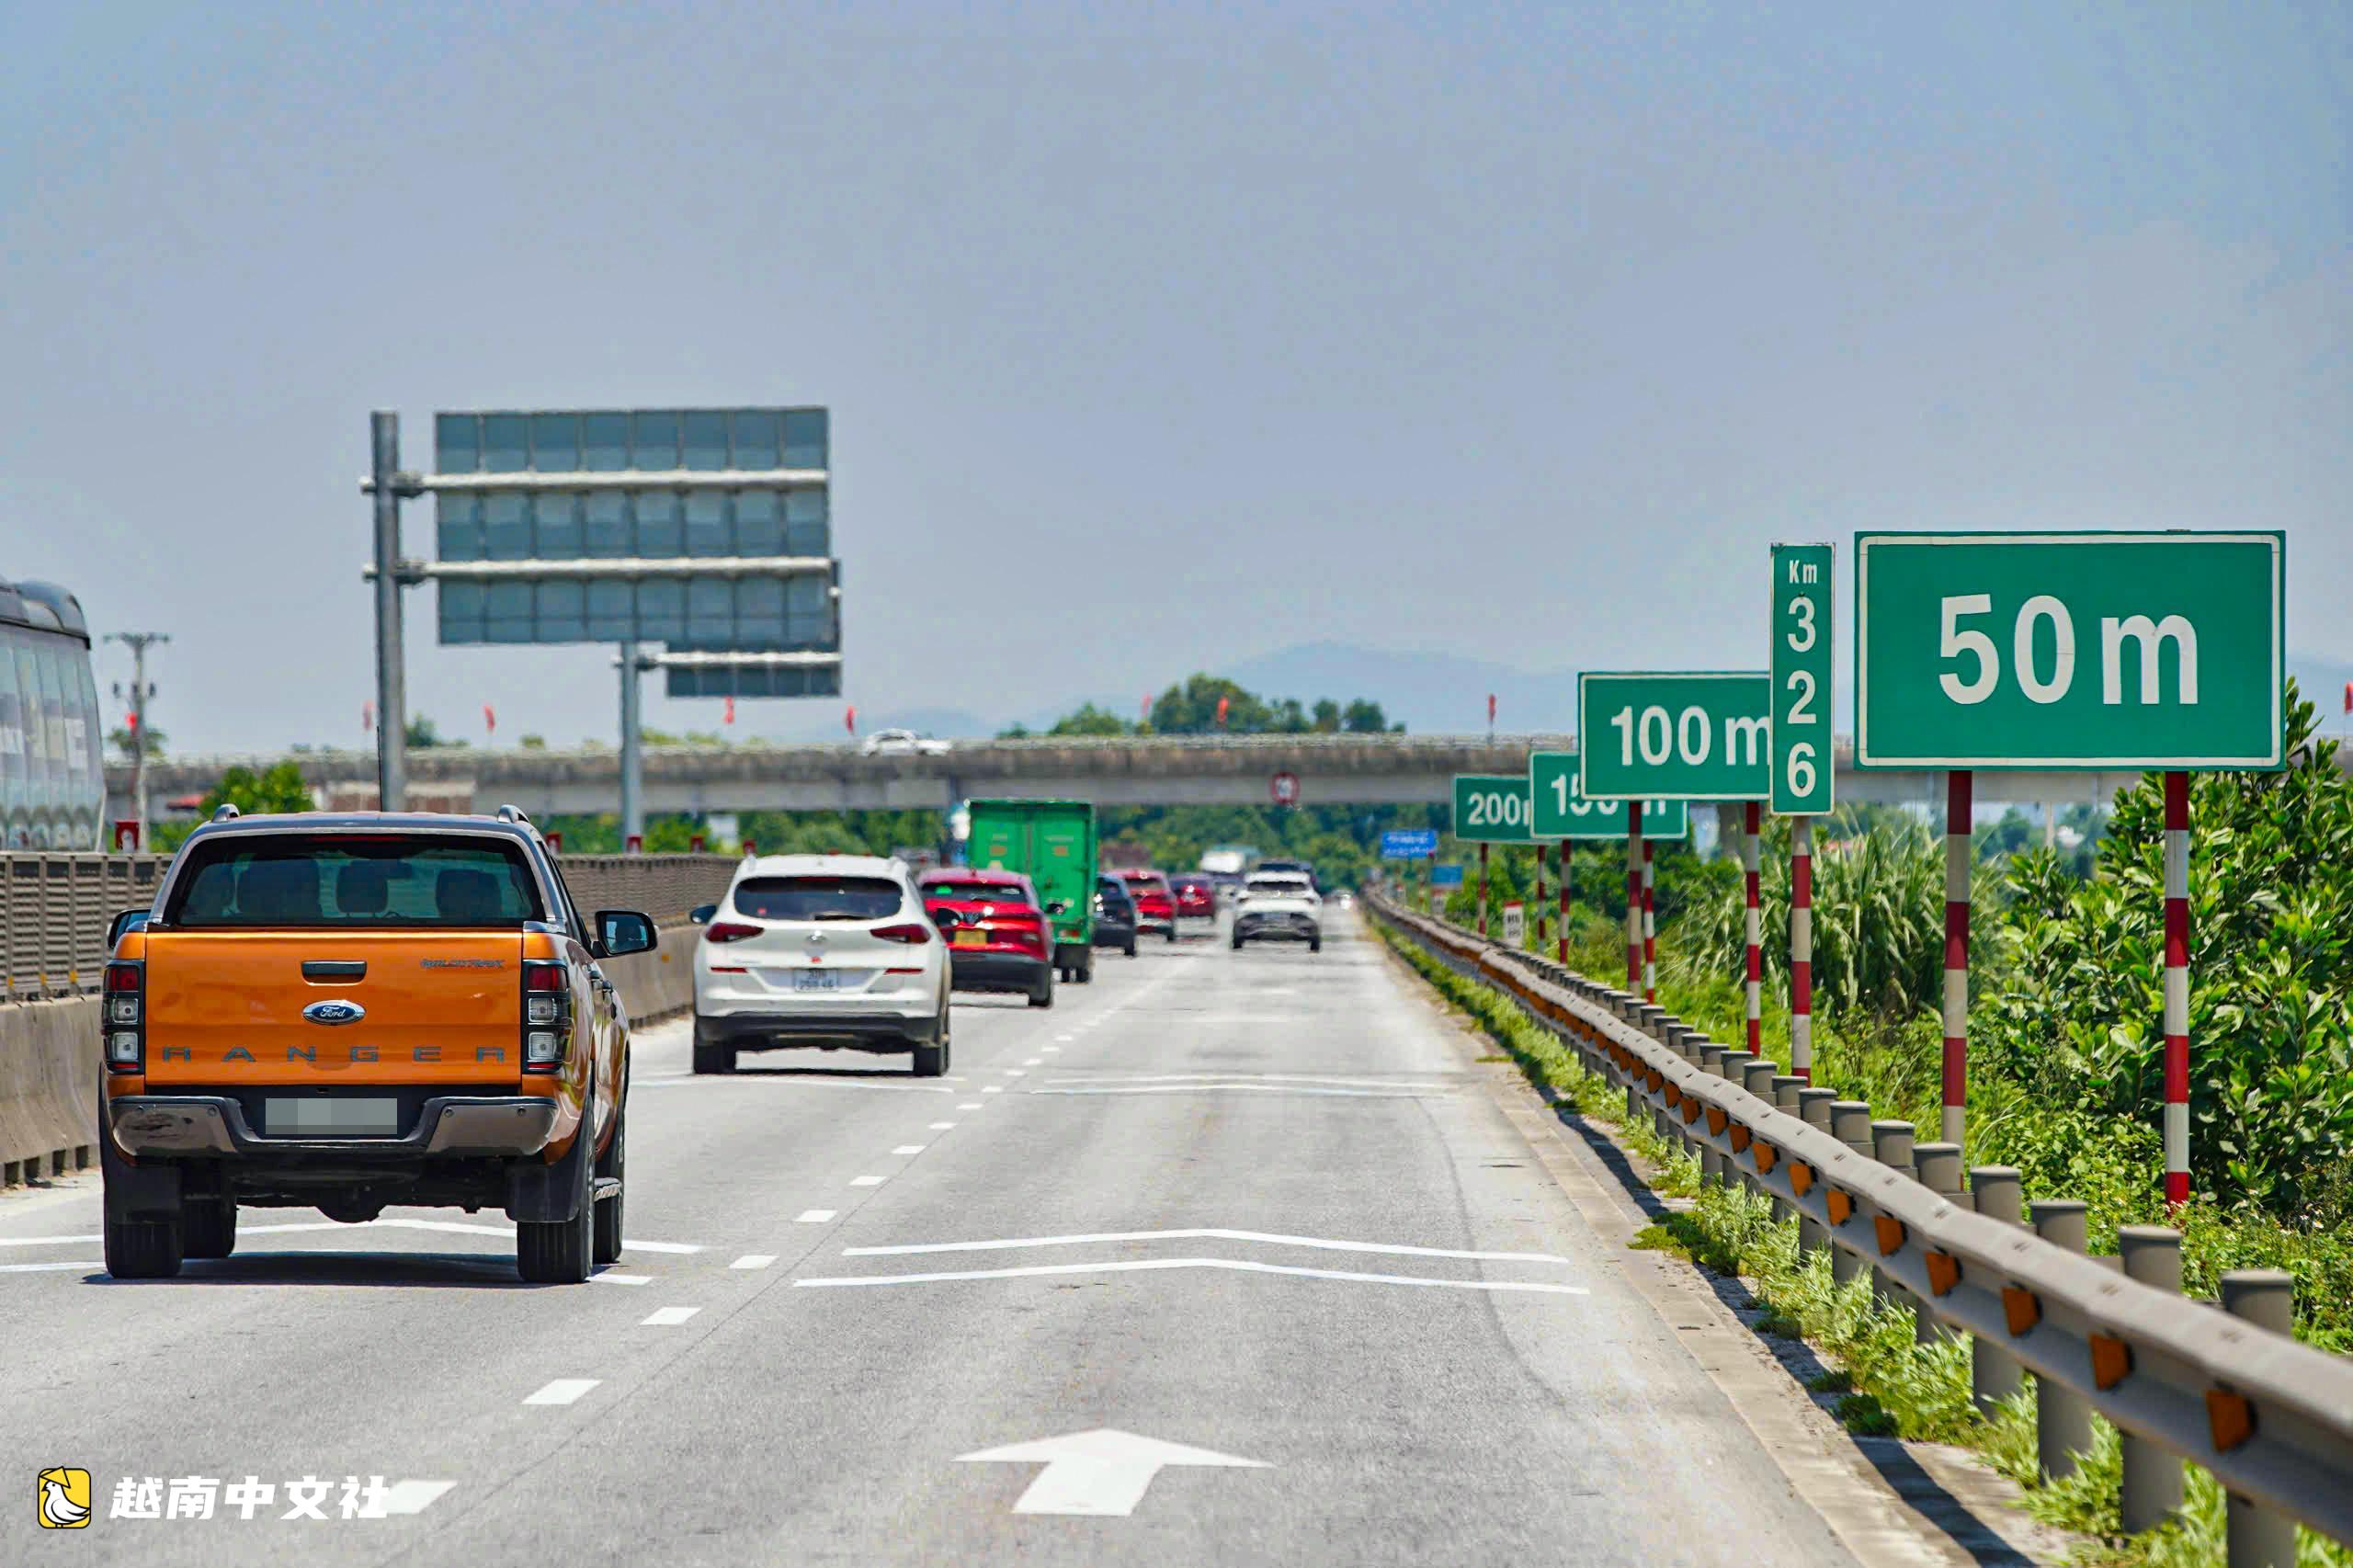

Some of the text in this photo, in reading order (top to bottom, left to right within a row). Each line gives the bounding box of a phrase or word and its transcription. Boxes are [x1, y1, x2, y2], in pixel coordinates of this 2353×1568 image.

[1789, 560, 1818, 584] Km
[1938, 593, 2199, 705] 50 m
[1611, 706, 1770, 766] 100 m
[1468, 792, 1529, 825] 200
[320, 1006, 347, 1017] Ford
[163, 1046, 505, 1062] RANGER
